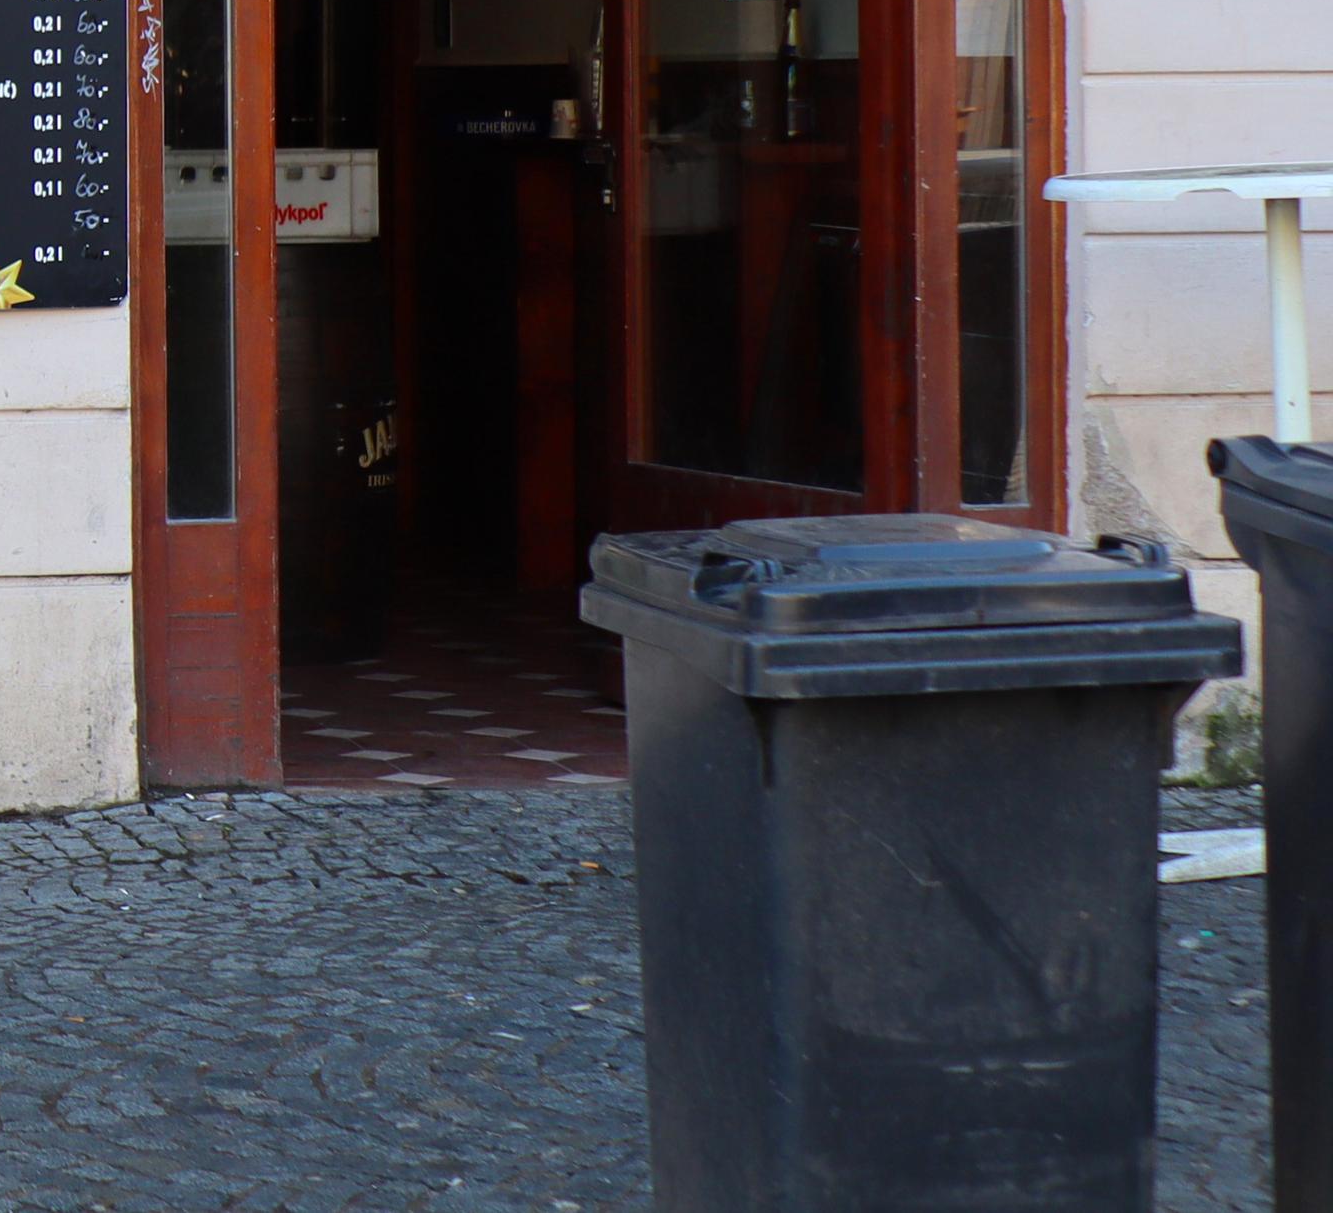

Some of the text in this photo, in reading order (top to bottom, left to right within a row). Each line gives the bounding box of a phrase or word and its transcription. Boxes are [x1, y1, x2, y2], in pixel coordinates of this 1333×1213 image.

[34, 15, 54, 33] 0,2
[34, 48, 54, 66] 0,2
[34, 81, 54, 99] 0,2
[34, 114, 54, 132] 0,2
[34, 148, 54, 165] 0,2
[34, 181, 53, 197] 0,1
[34, 247, 55, 263] 0,2
